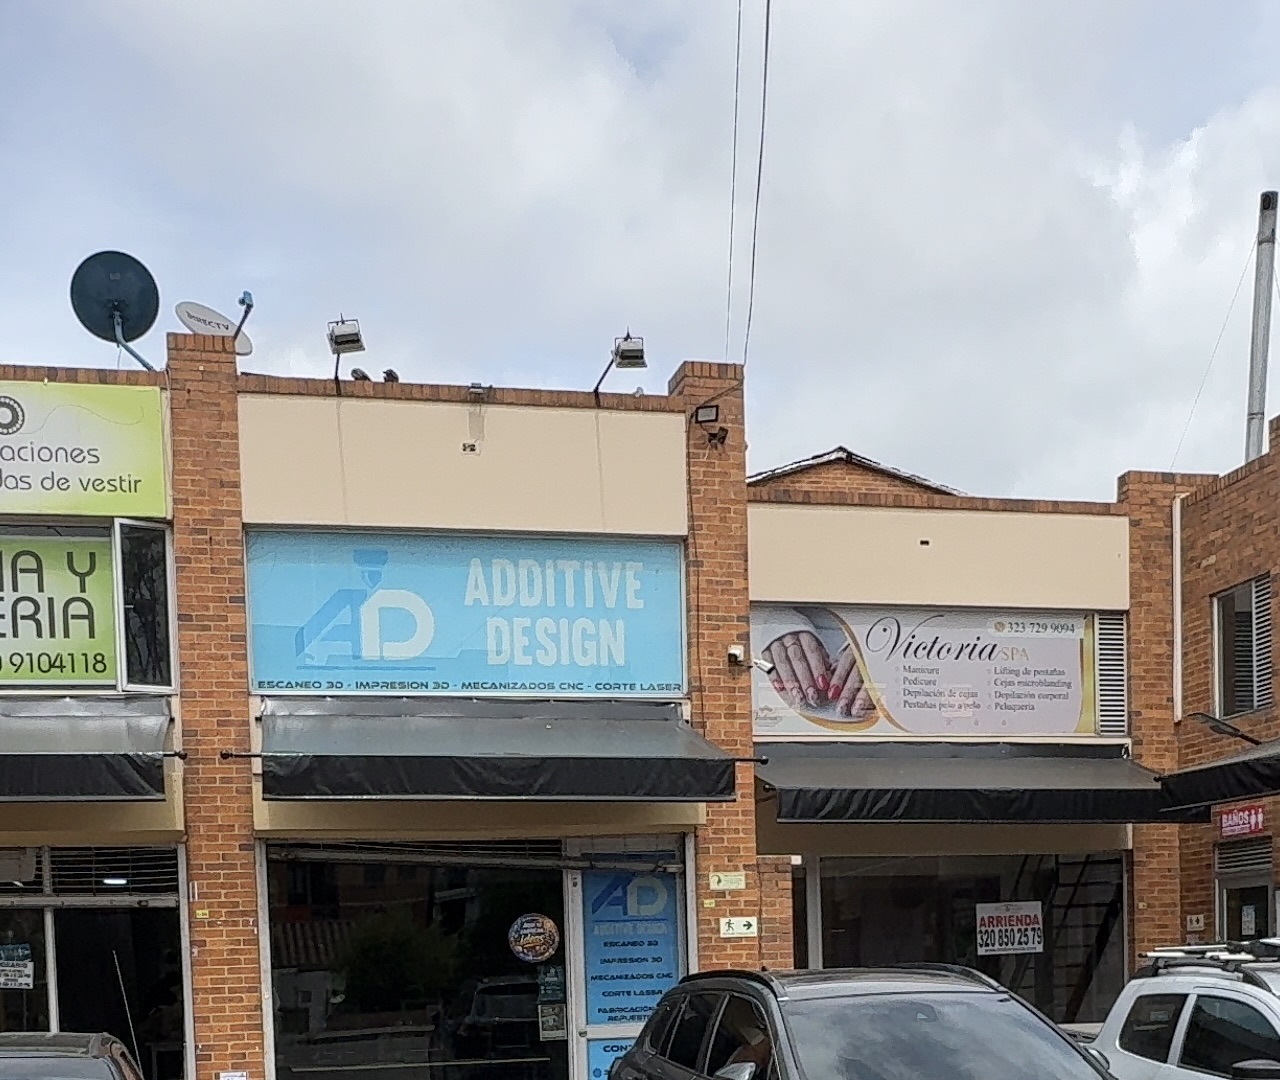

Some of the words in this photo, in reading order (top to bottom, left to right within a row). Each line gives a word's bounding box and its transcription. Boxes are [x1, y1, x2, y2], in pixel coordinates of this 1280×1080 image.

[41, 470, 71, 492] de
[78, 473, 143, 494] vestir
[67, 552, 96, 593] Y
[464, 557, 645, 609] ADDITIVE
[866, 614, 999, 662] Victoria
[1007, 621, 1028, 633] 323
[1030, 622, 1048, 633] 729
[1051, 622, 1075, 633] 9094
[486, 616, 626, 666] DESIGN
[9, 652, 107, 674] 9104118
[257, 680, 322, 689] ESCANEO
[326, 680, 343, 689] 3D
[355, 681, 428, 690] IMPRESION
[432, 681, 450, 690] 3D
[461, 681, 555, 690] MECANIZADOS
[559, 682, 584, 690] CNC
[595, 682, 636, 691] CORTE
[640, 683, 681, 691] LASER
[1222, 810, 1250, 828] BAÑOS
[979, 913, 1040, 928] ARRIENDA
[978, 928, 996, 948] 320
[998, 928, 1015, 946] 850
[1017, 927, 1030, 945] 25
[1031, 926, 1042, 945] 79
